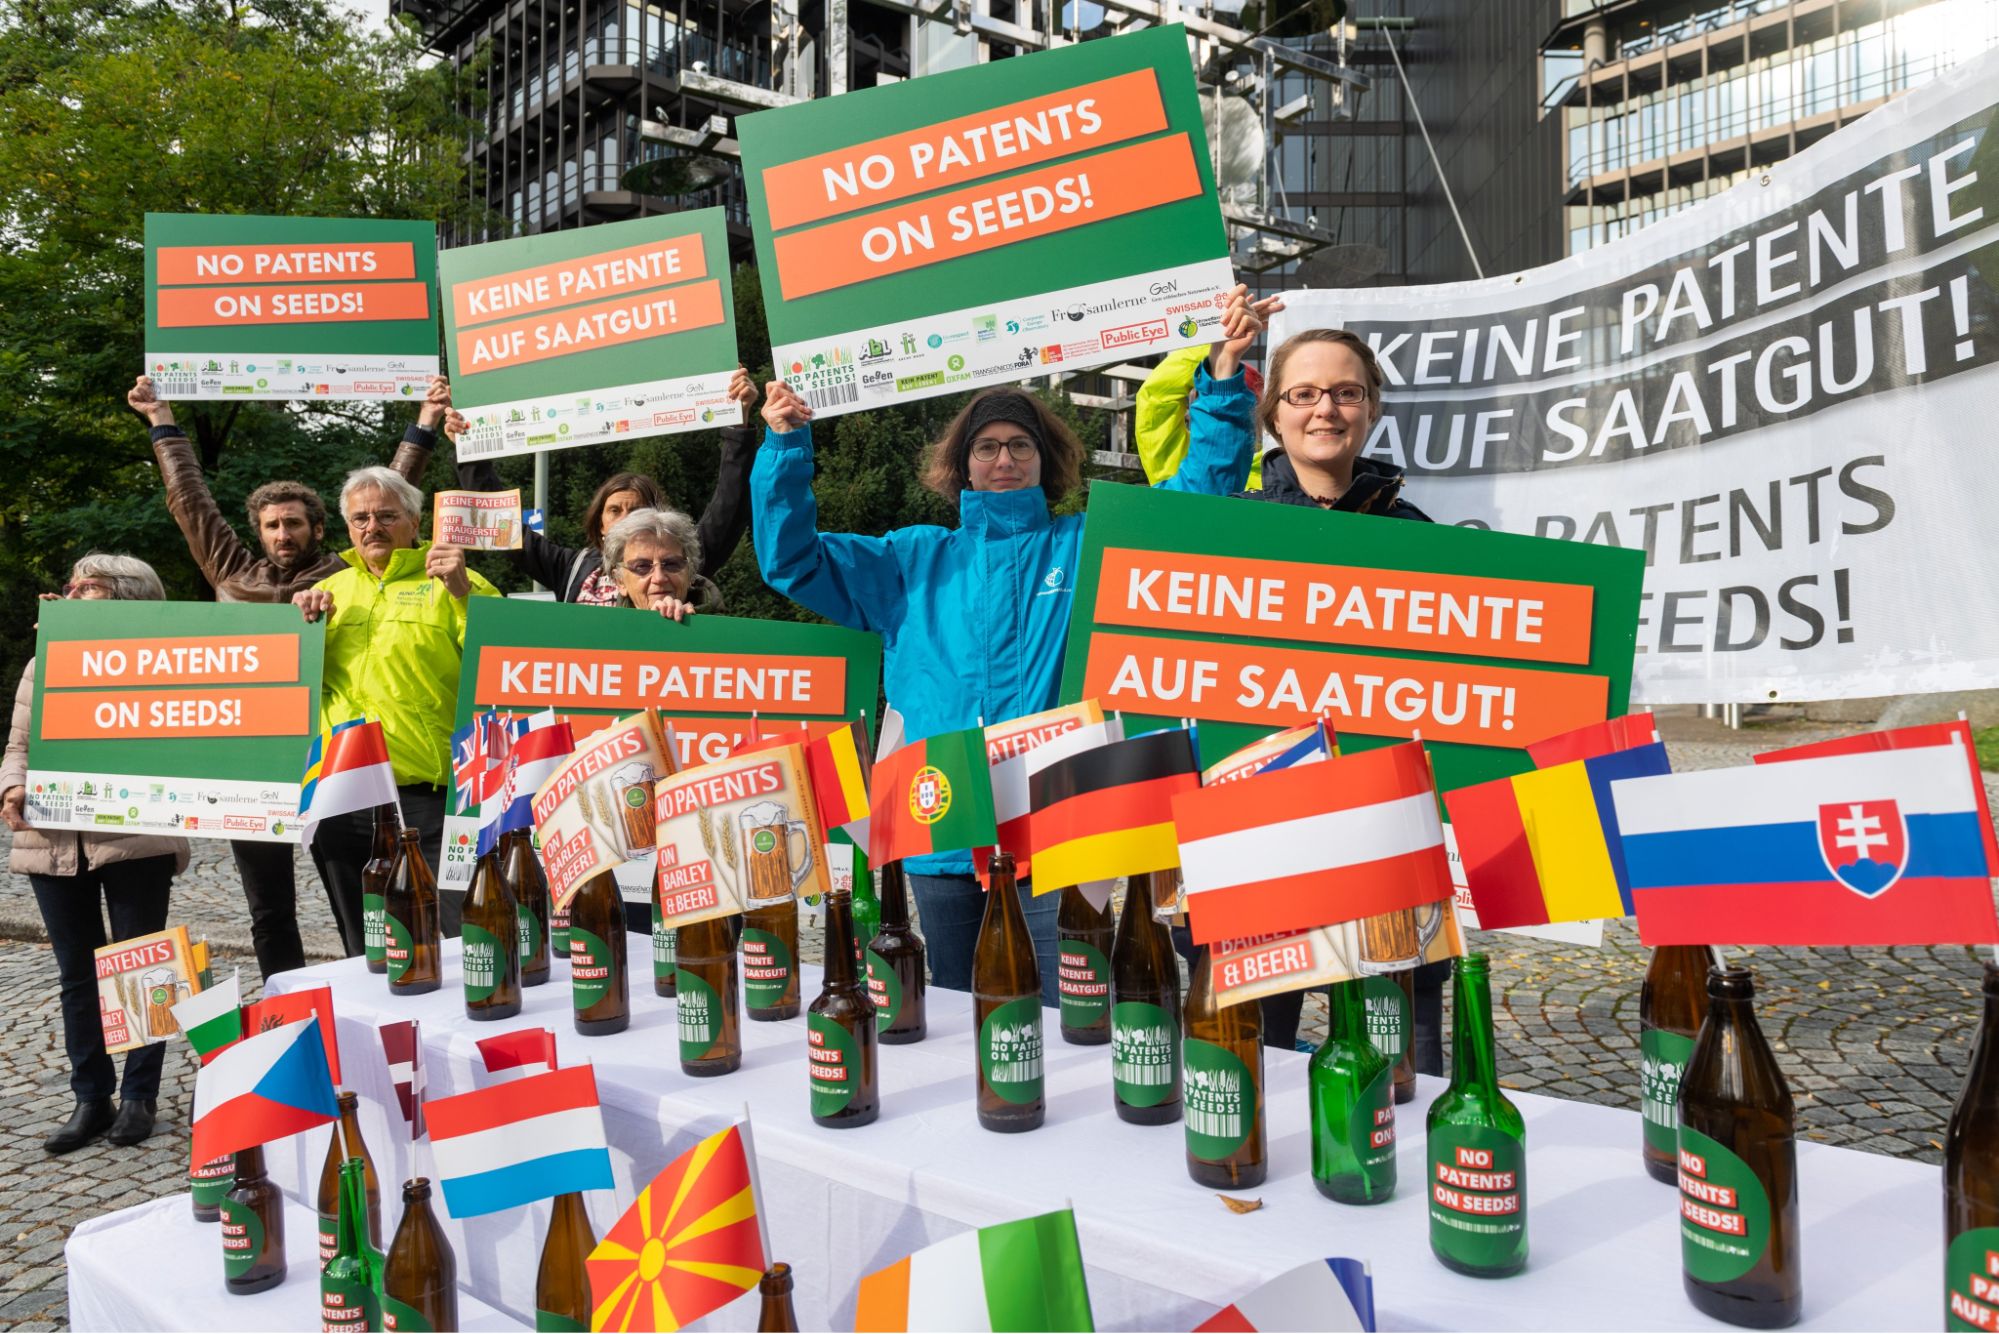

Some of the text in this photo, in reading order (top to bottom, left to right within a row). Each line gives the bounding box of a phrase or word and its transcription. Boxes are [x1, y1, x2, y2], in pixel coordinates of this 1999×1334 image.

[822, 99, 1102, 201] NO PATENTS
[861, 174, 1095, 263] ON SEEDS!
[196, 250, 377, 276] NO PATENTS
[1370, 137, 1984, 387] KEINE PATENTE
[468, 248, 681, 316] KEINE PATENTE
[1150, 279, 1177, 295] GeN
[214, 291, 364, 318] ON SEEDS!
[1166, 300, 1212, 315] SWISSAID
[471, 299, 678, 364] AUF SAATGUT!
[1105, 325, 1164, 345] Public Eye
[1014, 359, 1030, 369] FORA
[1361, 274, 1975, 471] AUF SAATGUT!
[784, 365, 855, 385] NO PATENTS
[811, 373, 856, 389] SEEDS!
[946, 371, 971, 384] OXFAM
[656, 415, 679, 424] Public
[472, 425, 502, 434] PATENTS
[443, 497, 516, 508] KEINE PATENTE
[443, 516, 460, 524] AUF
[442, 526, 498, 536] BRAUGERSTE
[452, 536, 474, 544] BIER!
[1127, 568, 1544, 643] KEINE PATENTE
[1637, 567, 1856, 654] EDS!
[82, 645, 259, 677] NO PATENTS
[501, 661, 811, 701] KEINE PATENTE
[1108, 655, 1515, 731] AUF SAATGUT!
[95, 699, 242, 729] ON SEEDS!
[537, 796, 559, 823] NO
[558, 731, 641, 799] PATENTS
[657, 766, 779, 822] NO PATENTS
[226, 818, 248, 828] Public
[448, 846, 465, 854] NO
[546, 835, 561, 857] ON
[550, 830, 587, 879] BARLEY
[447, 854, 465, 862] ON
[661, 849, 676, 867] ON
[554, 853, 594, 899] & BEER!
[663, 863, 708, 891] BARLEY
[666, 890, 714, 915] & BEER!
[99, 942, 170, 975] PATENTS
[1061, 955, 1086, 966] KEINE
[1224, 944, 1308, 987] & BEER!
[1063, 982, 1107, 994] SAATGUT!
[1367, 1015, 1400, 1025] TENTS
[809, 1032, 821, 1042] NO
[991, 1042, 1008, 1052] NO
[991, 1048, 1042, 1061] ON SEED
[1124, 1045, 1171, 1055] PATENTS
[1128, 1055, 1172, 1065] SEEDS!
[811, 1065, 843, 1078] SEEDS!
[1189, 1086, 1240, 1102] PATENTS
[1193, 1098, 1240, 1113] SEEDS!
[1374, 1131, 1391, 1144] ON
[1460, 1150, 1489, 1166] NO
[1680, 1152, 1702, 1172] NO
[198, 1163, 235, 1177] SAATGU
[1439, 1166, 1512, 1189] PATENTS
[1678, 1174, 1731, 1205] ATENTS
[1436, 1187, 1516, 1212] ON SEEDS!
[1685, 1202, 1739, 1232] SEEDS!
[326, 1294, 342, 1304] NO
[1952, 1293, 1991, 1326] AUF
[329, 1321, 364, 1333] SEEDS!
